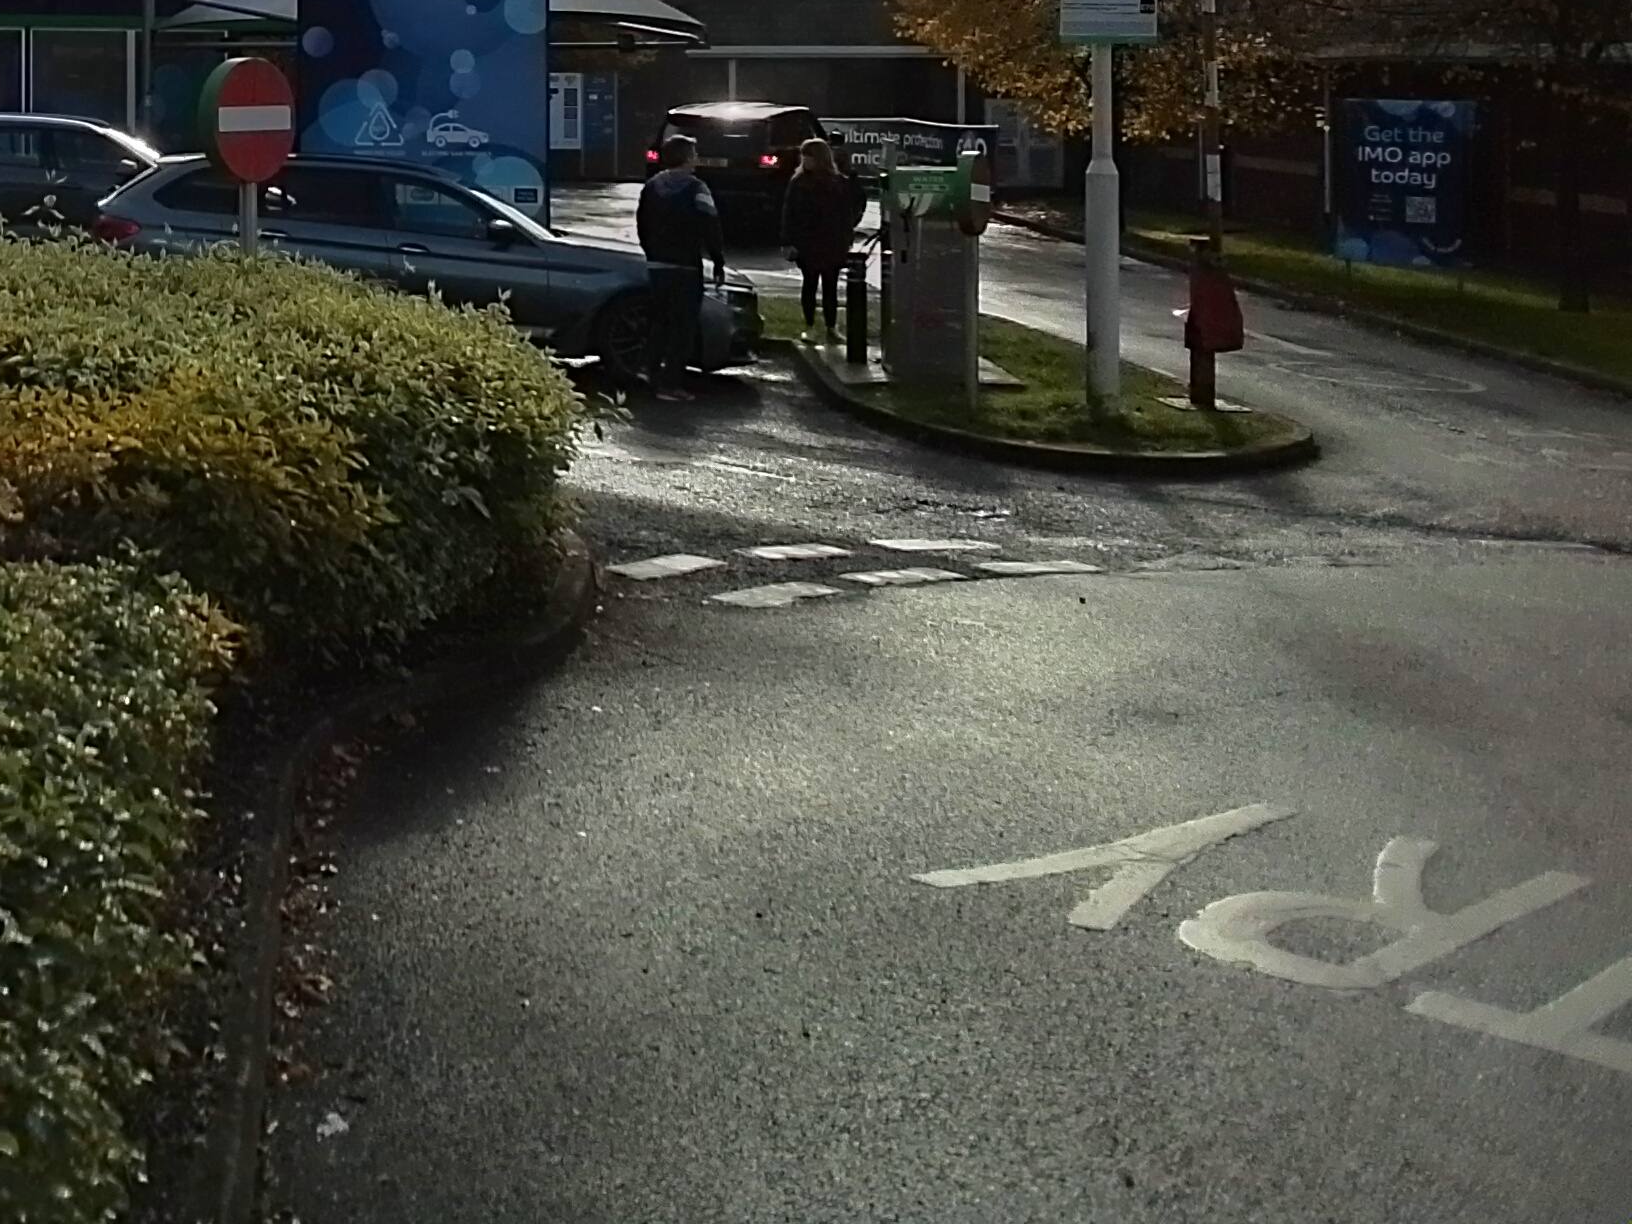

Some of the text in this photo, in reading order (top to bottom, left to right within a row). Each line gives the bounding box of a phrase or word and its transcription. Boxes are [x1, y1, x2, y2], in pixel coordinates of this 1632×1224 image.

[1364, 125, 1444, 143] Get the
[1358, 146, 1451, 168] IMO app
[1371, 168, 1437, 189] today
